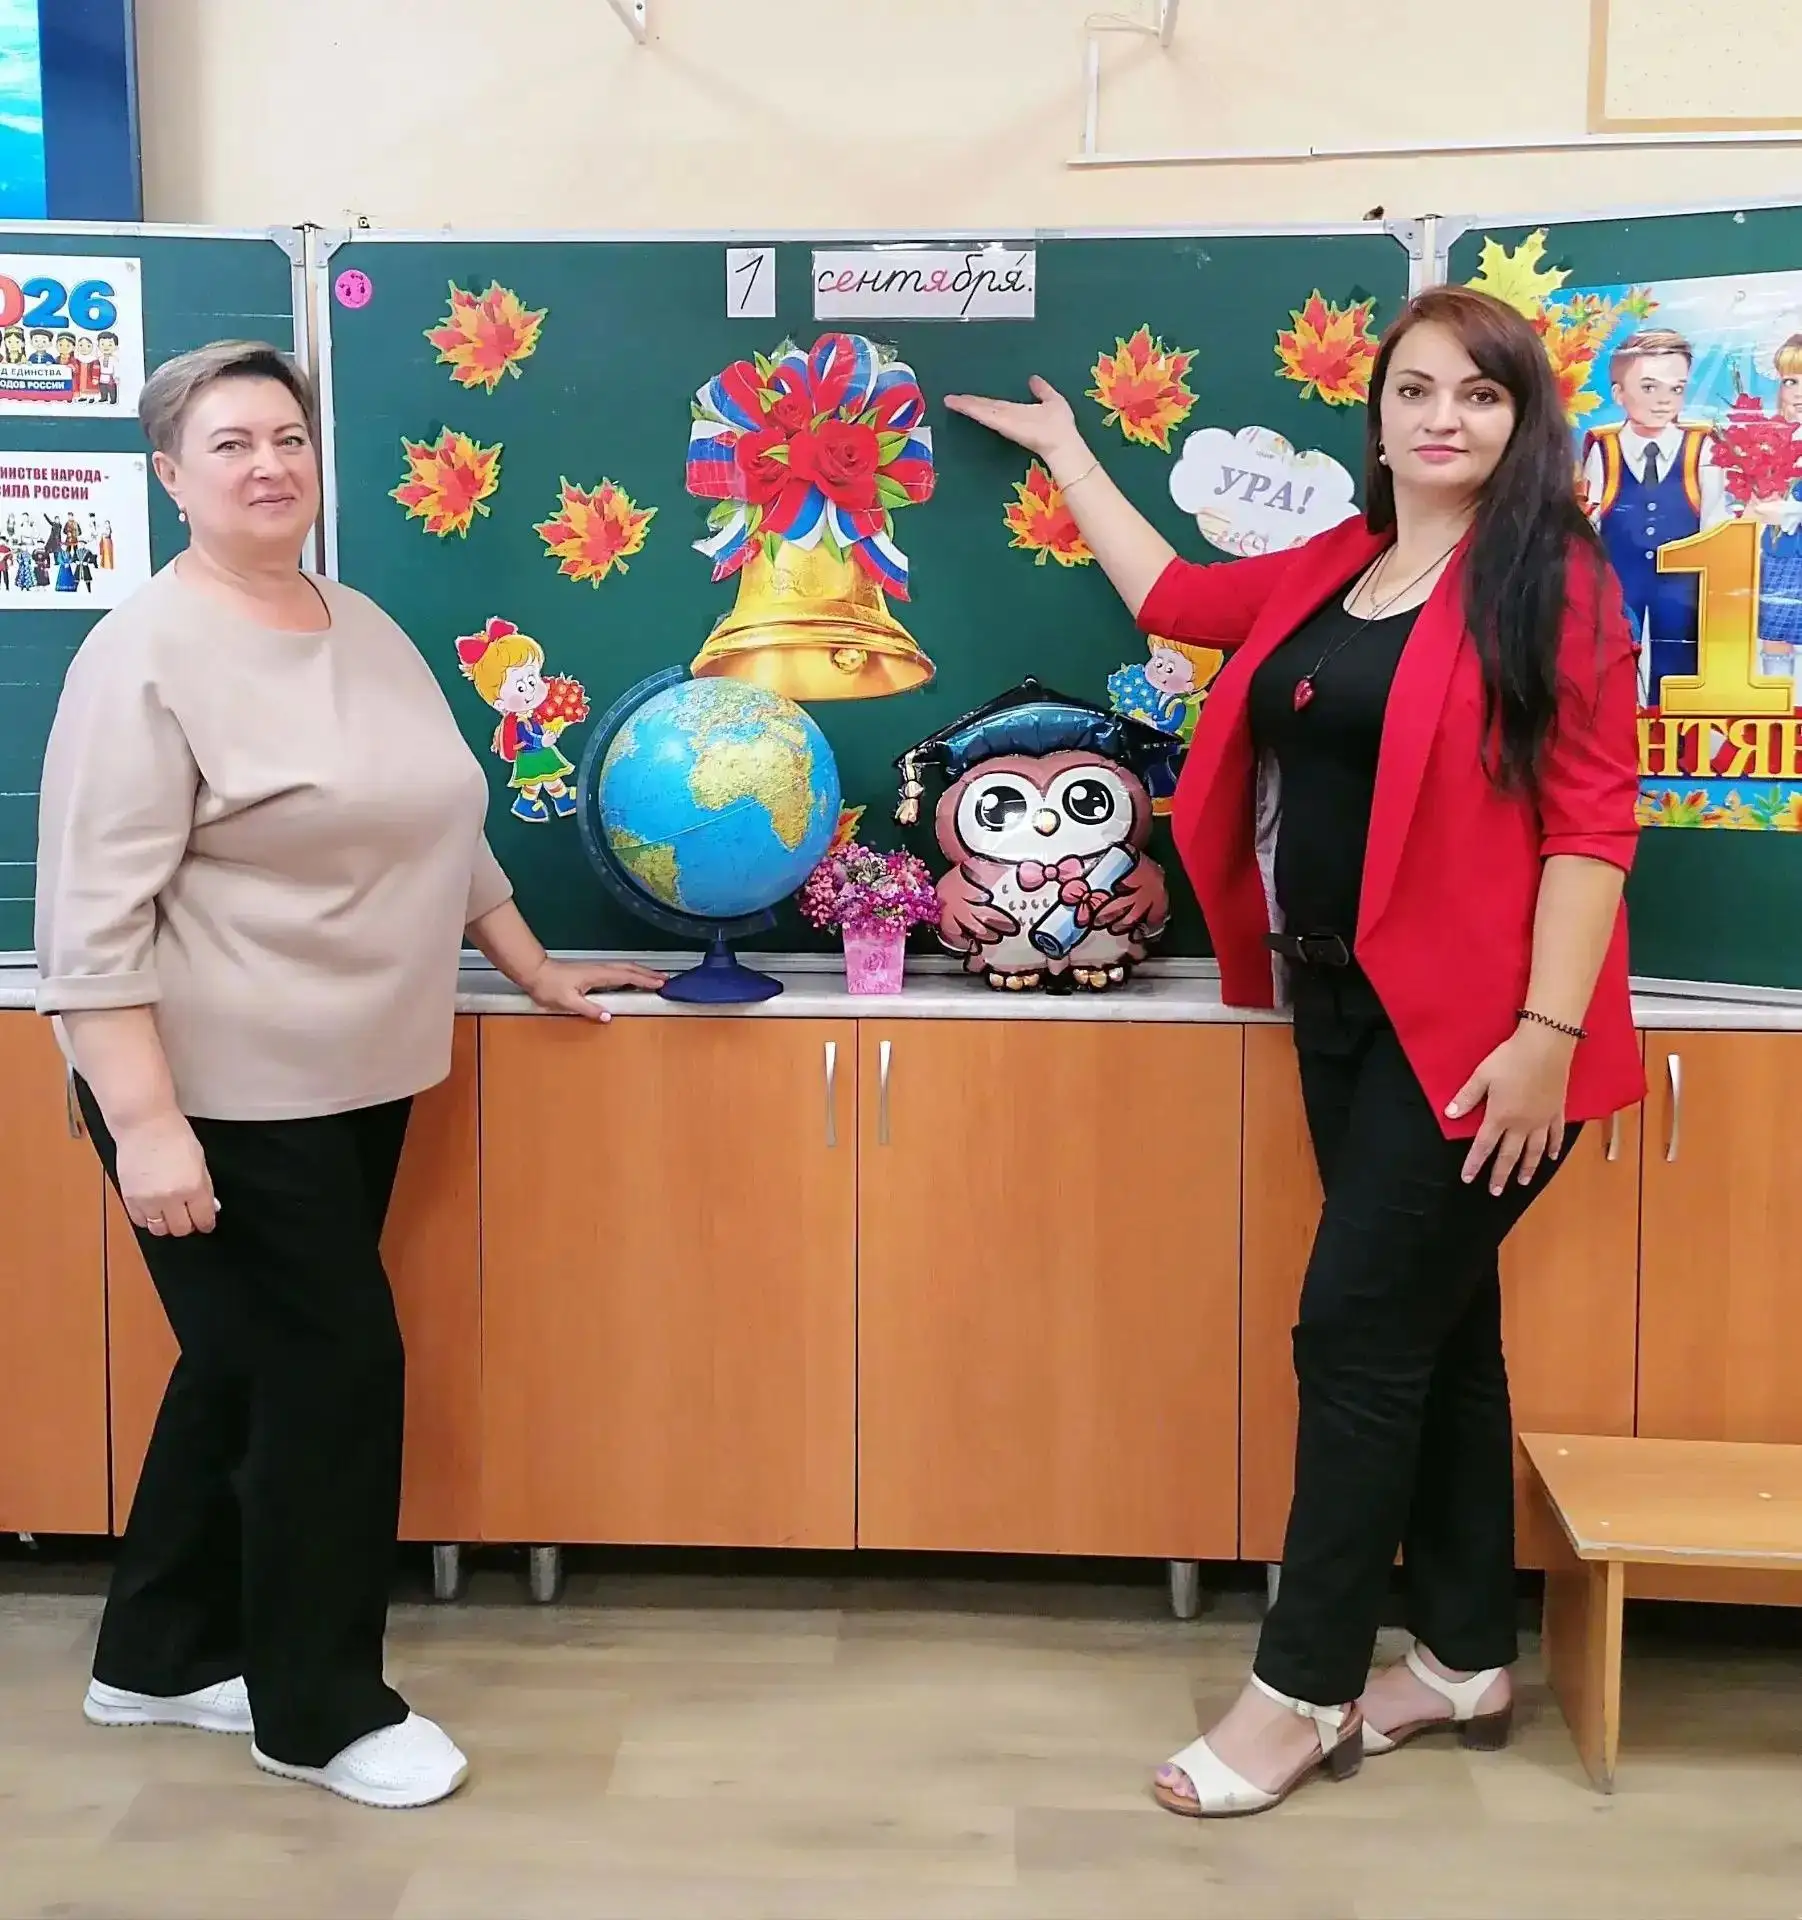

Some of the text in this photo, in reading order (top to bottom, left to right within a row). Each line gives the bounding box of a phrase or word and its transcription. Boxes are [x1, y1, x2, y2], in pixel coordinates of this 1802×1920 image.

[735, 254, 764, 310] 1
[11, 368, 62, 376] ЕДИНСТВА
[28, 381, 65, 389] РОССИИ
[51, 468, 102, 483] НАРОДА
[0, 484, 88, 500] ИЛА РОССИИ
[1213, 465, 1315, 515] УРА!
[1657, 519, 1794, 715] 1
